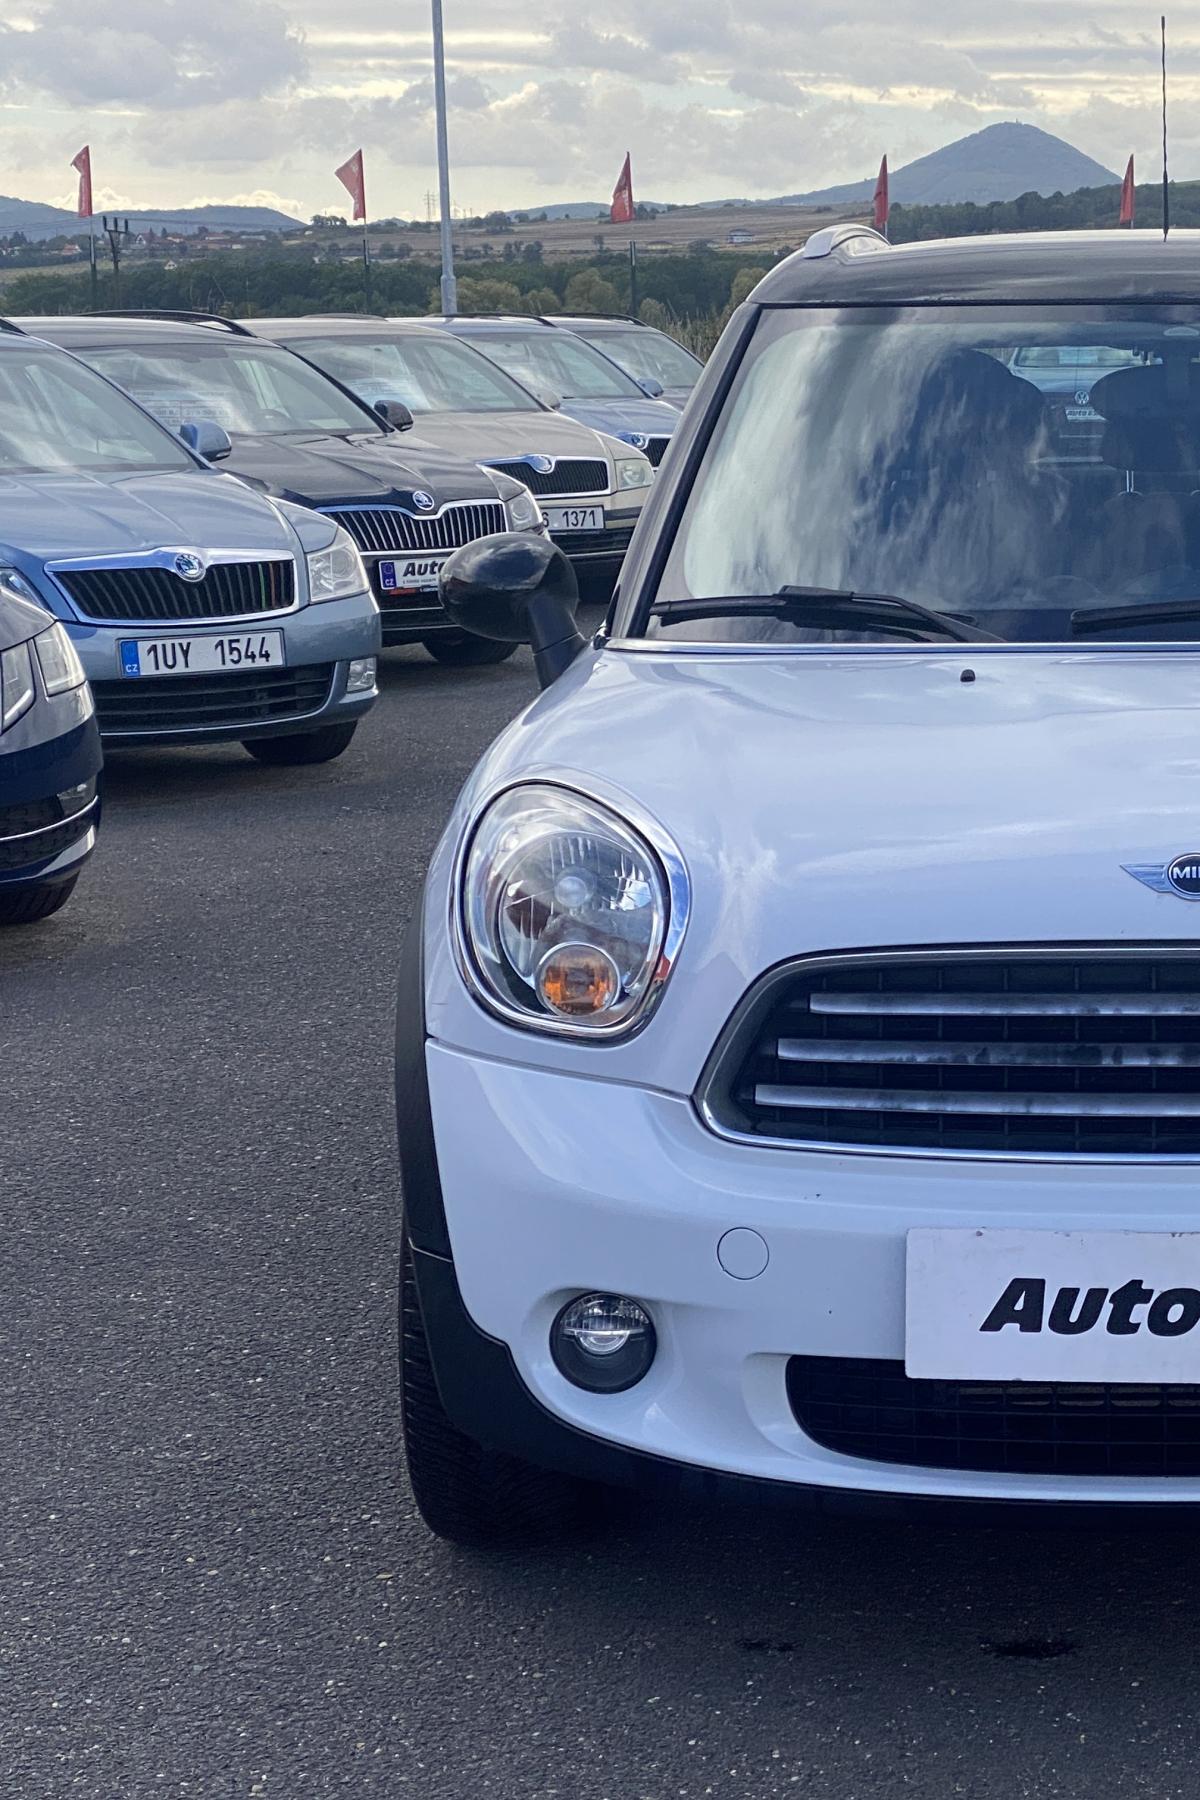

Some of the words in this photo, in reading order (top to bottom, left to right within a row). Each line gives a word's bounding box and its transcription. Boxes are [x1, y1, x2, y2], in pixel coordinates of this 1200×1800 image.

[562, 510, 595, 527] 1371
[147, 642, 191, 671] 1UY
[214, 636, 270, 666] 1544
[125, 663, 138, 673] CZ
